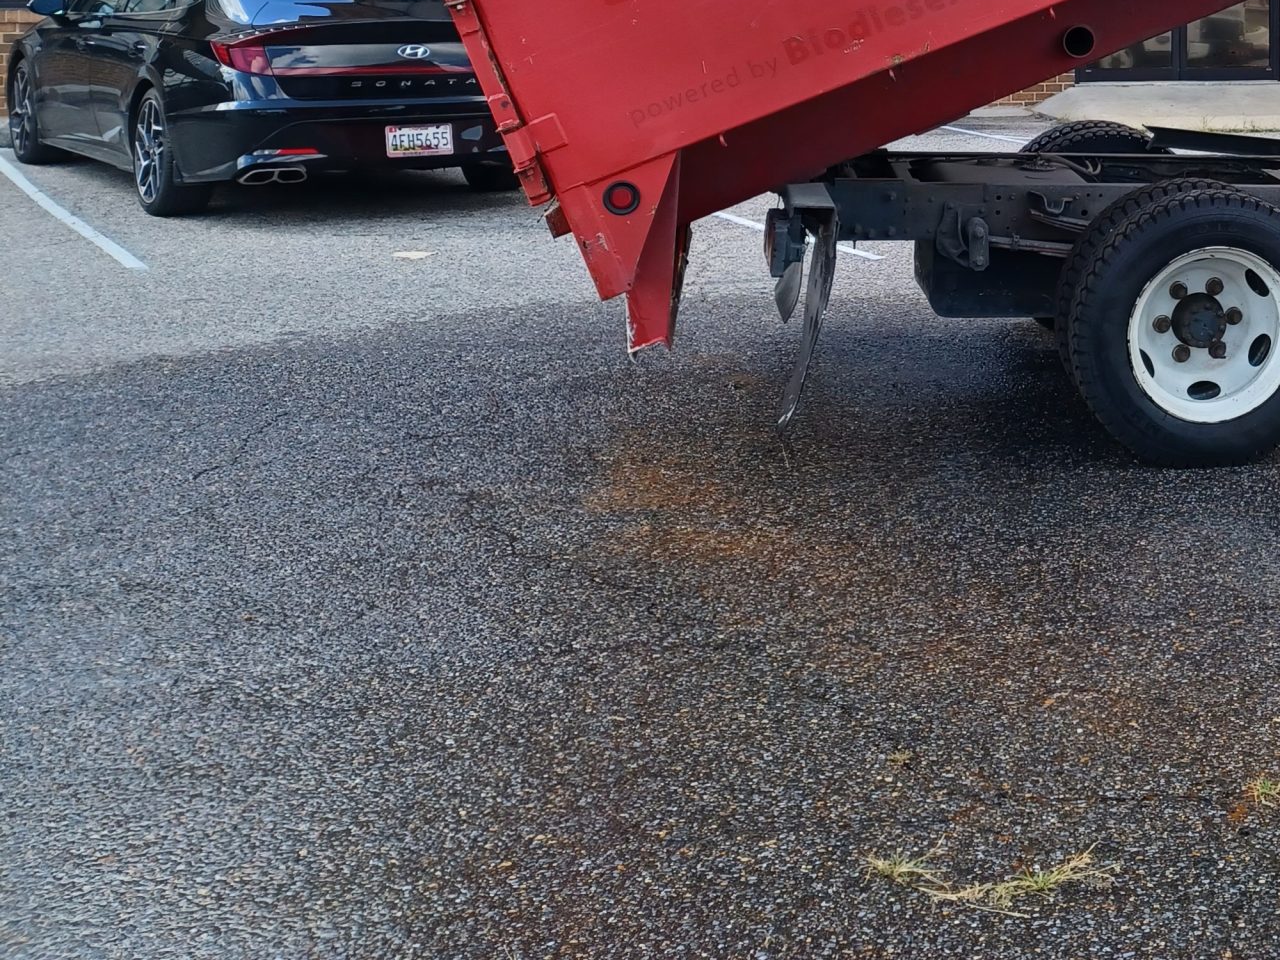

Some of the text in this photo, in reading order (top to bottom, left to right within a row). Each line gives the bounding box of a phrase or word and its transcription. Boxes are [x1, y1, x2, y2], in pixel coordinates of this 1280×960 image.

[351, 78, 476, 88] SONATA
[628, 65, 742, 128] powered
[746, 55, 778, 80] by
